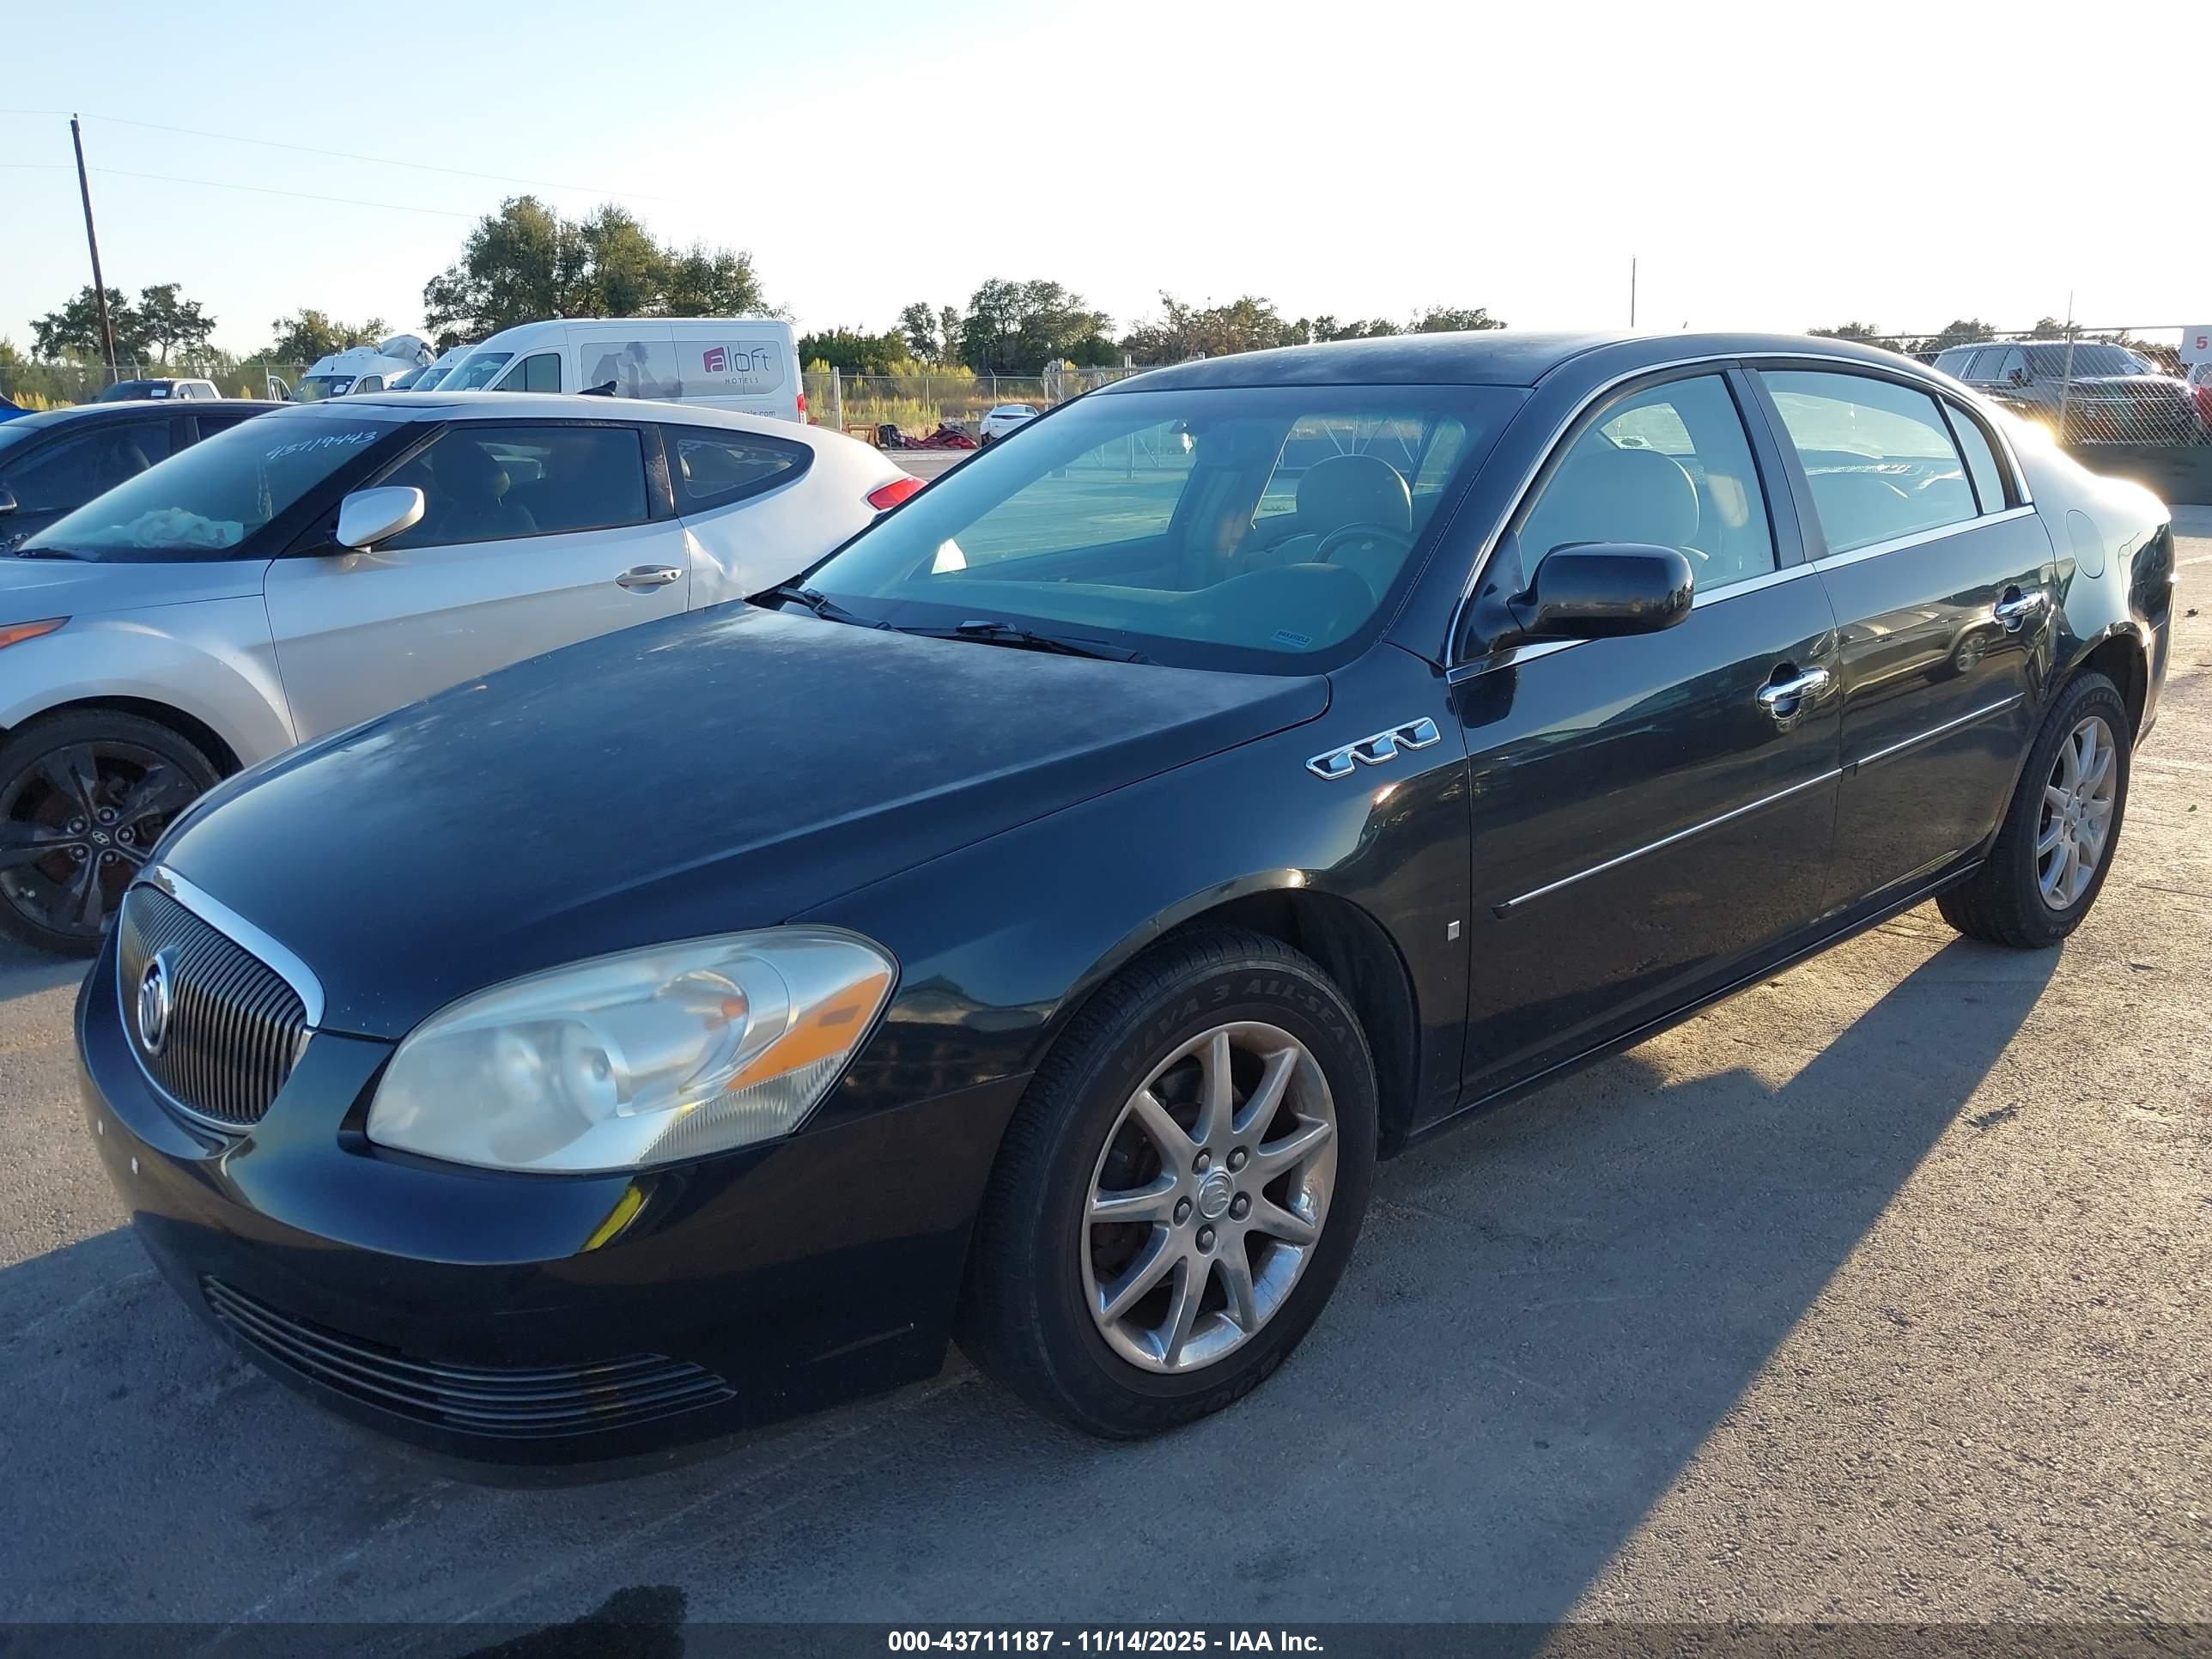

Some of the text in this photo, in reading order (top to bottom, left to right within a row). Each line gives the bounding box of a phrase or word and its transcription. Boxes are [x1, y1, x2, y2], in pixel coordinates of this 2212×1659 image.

[2196, 336, 2209, 350] 5
[703, 345, 770, 373] aloft
[725, 377, 759, 386] HOTELS
[265, 431, 378, 460] 43719443
[1120, 997, 1200, 1073] VIVA
[1211, 983, 1231, 1003] 3
